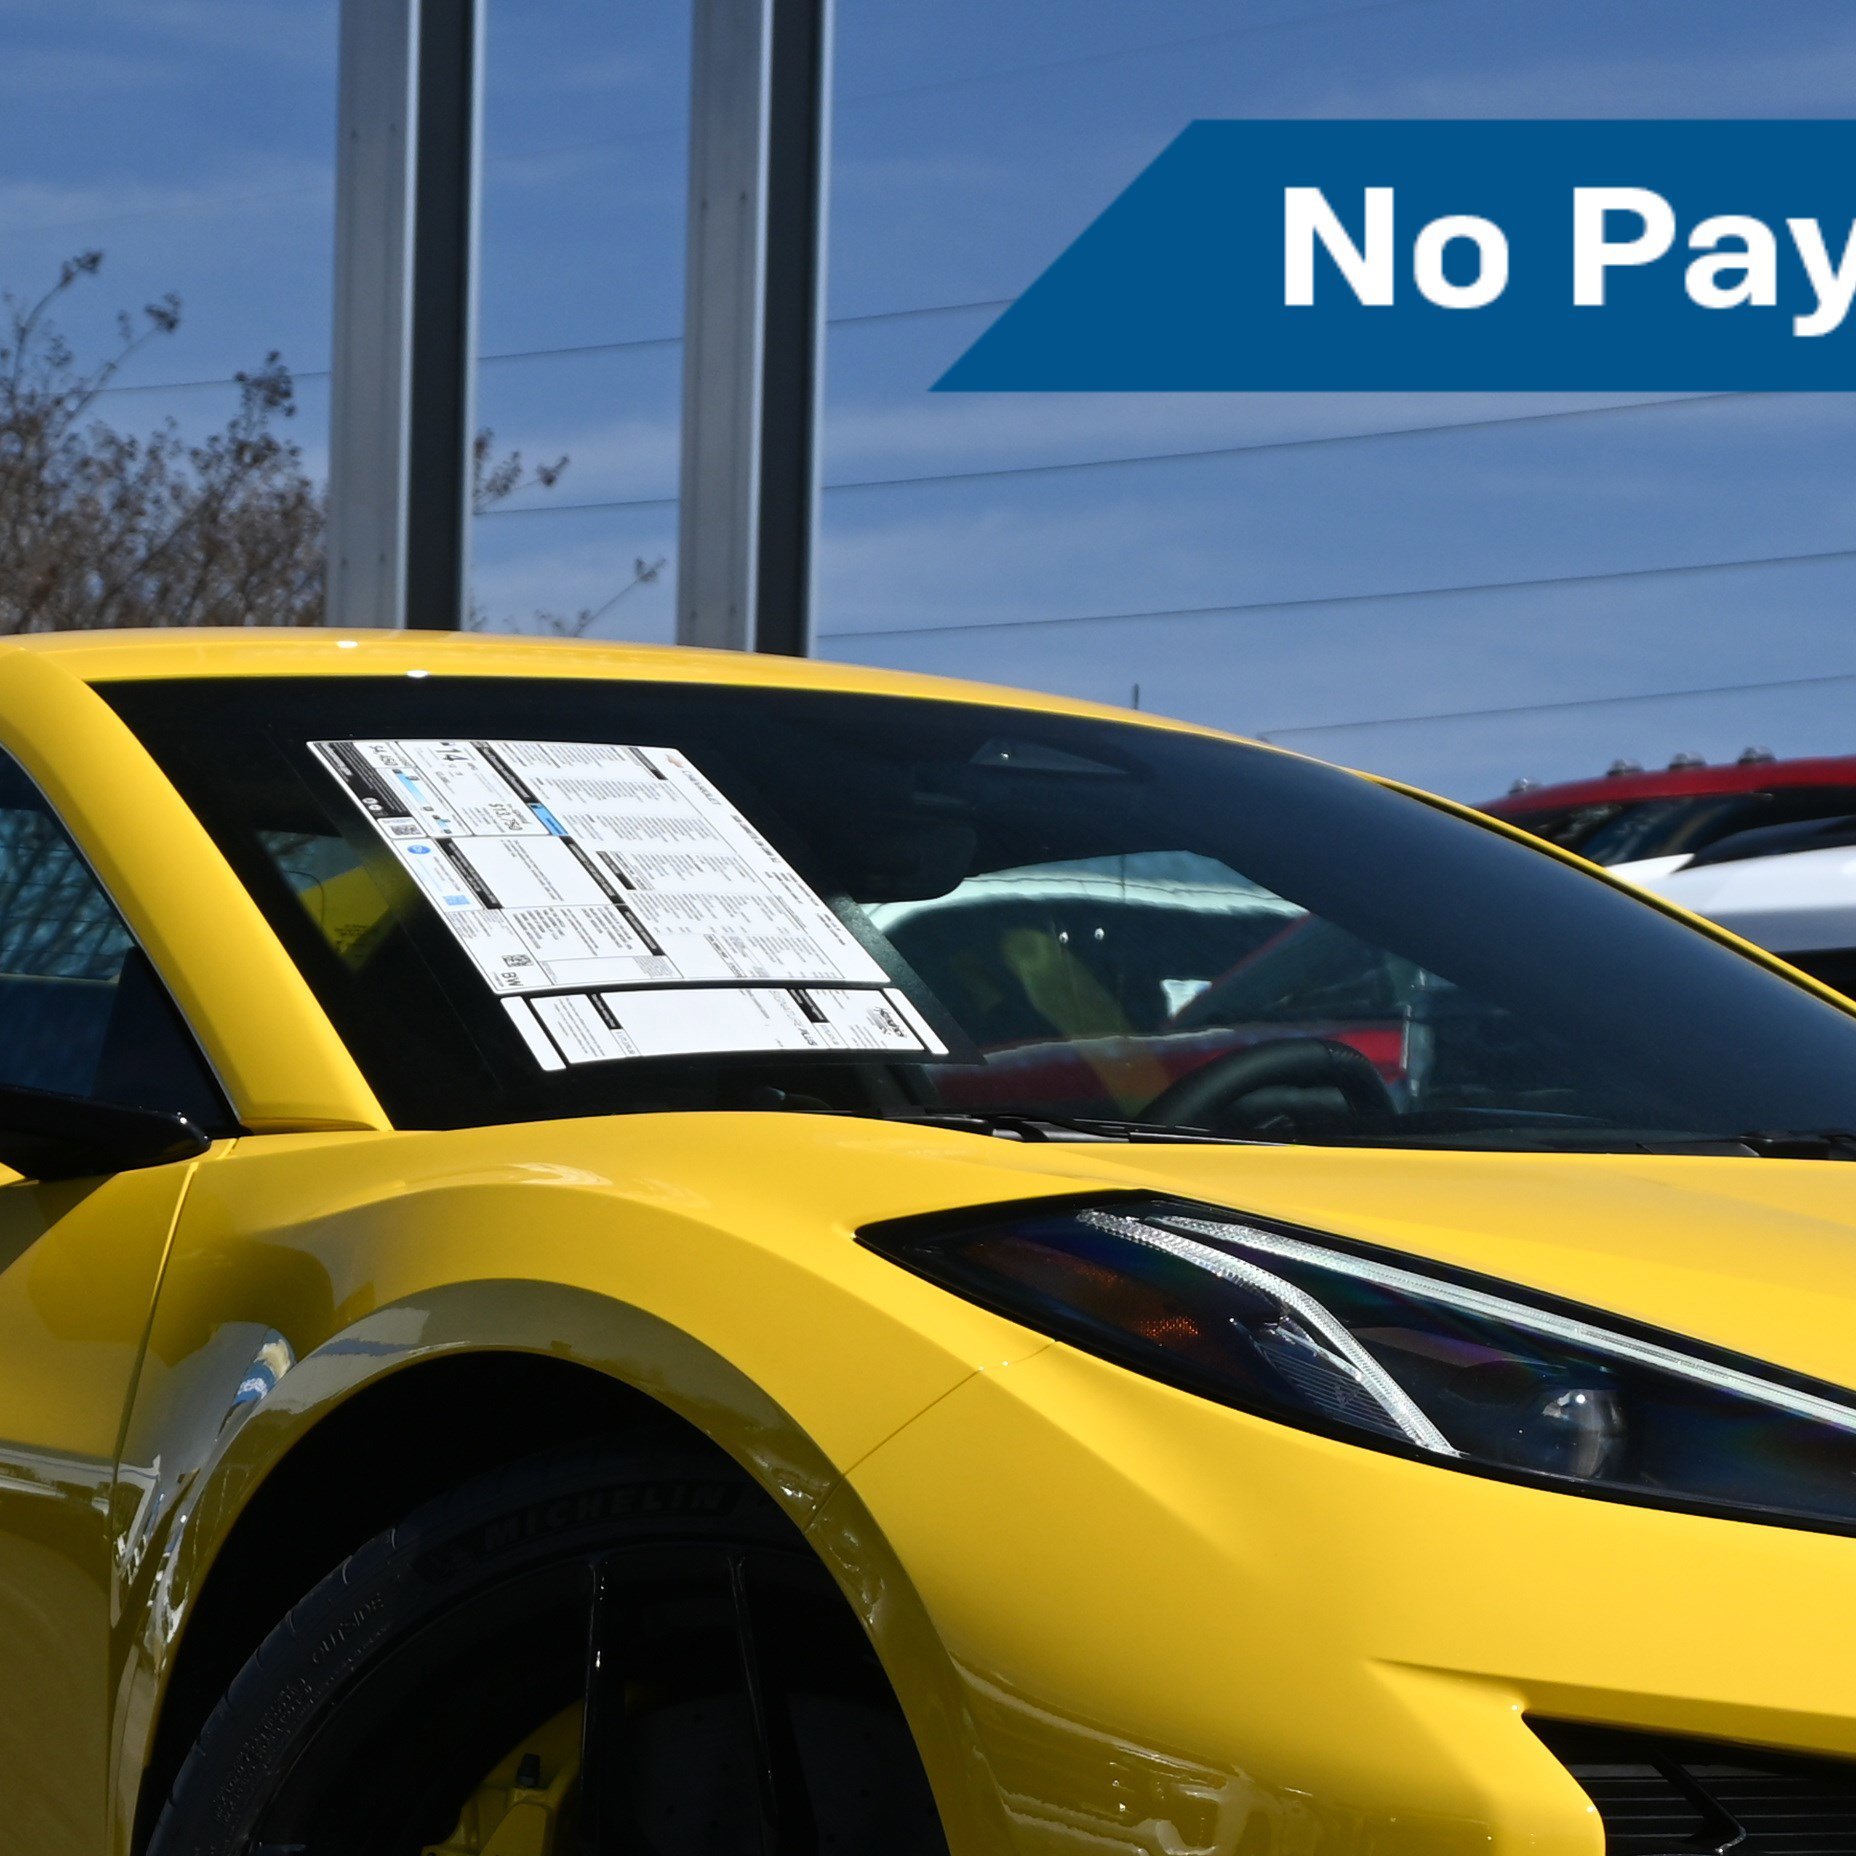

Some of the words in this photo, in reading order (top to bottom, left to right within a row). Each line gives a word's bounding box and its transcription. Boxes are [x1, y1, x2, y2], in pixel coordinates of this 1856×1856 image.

[432, 748, 470, 761] 14
[498, 972, 524, 986] BW
[483, 1485, 727, 1552] MICHELIN
